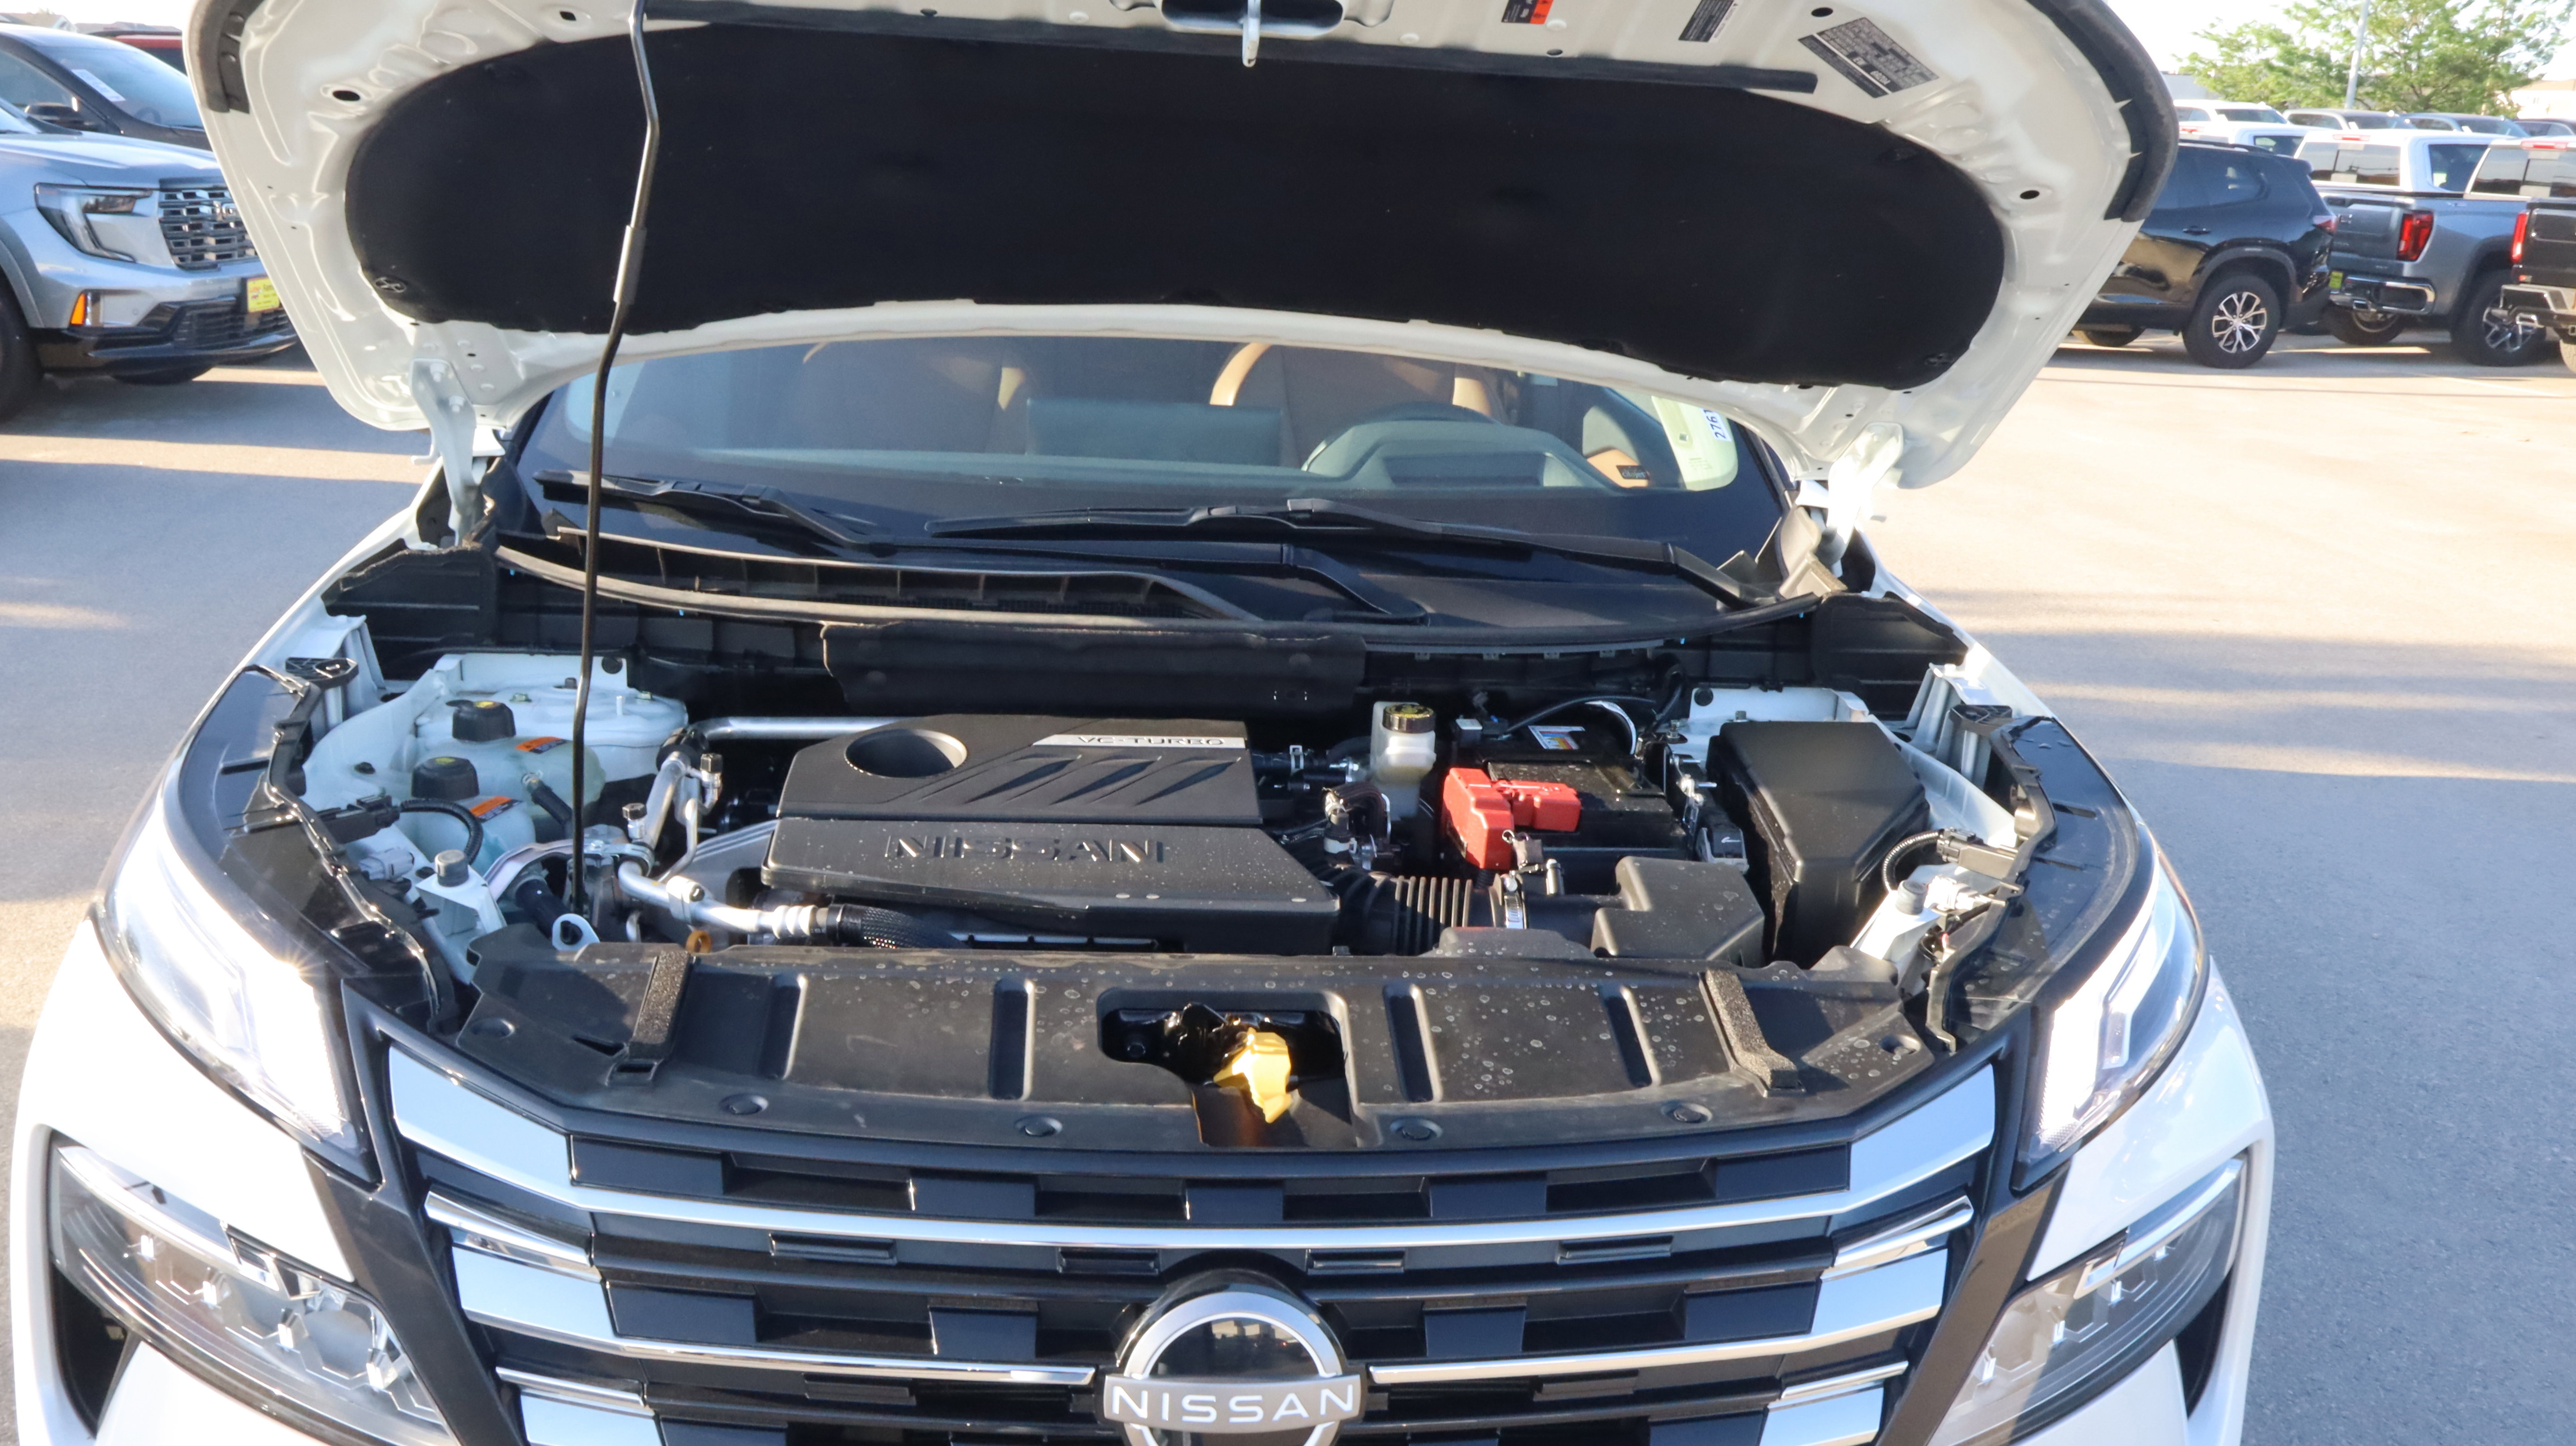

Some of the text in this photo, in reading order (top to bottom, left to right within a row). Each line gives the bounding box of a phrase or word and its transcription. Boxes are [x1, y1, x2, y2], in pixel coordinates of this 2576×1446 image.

[1078, 735, 1224, 745] VC-TURBO
[883, 835, 1164, 863] NISSAN
[1112, 1384, 1353, 1423] NISSAN
